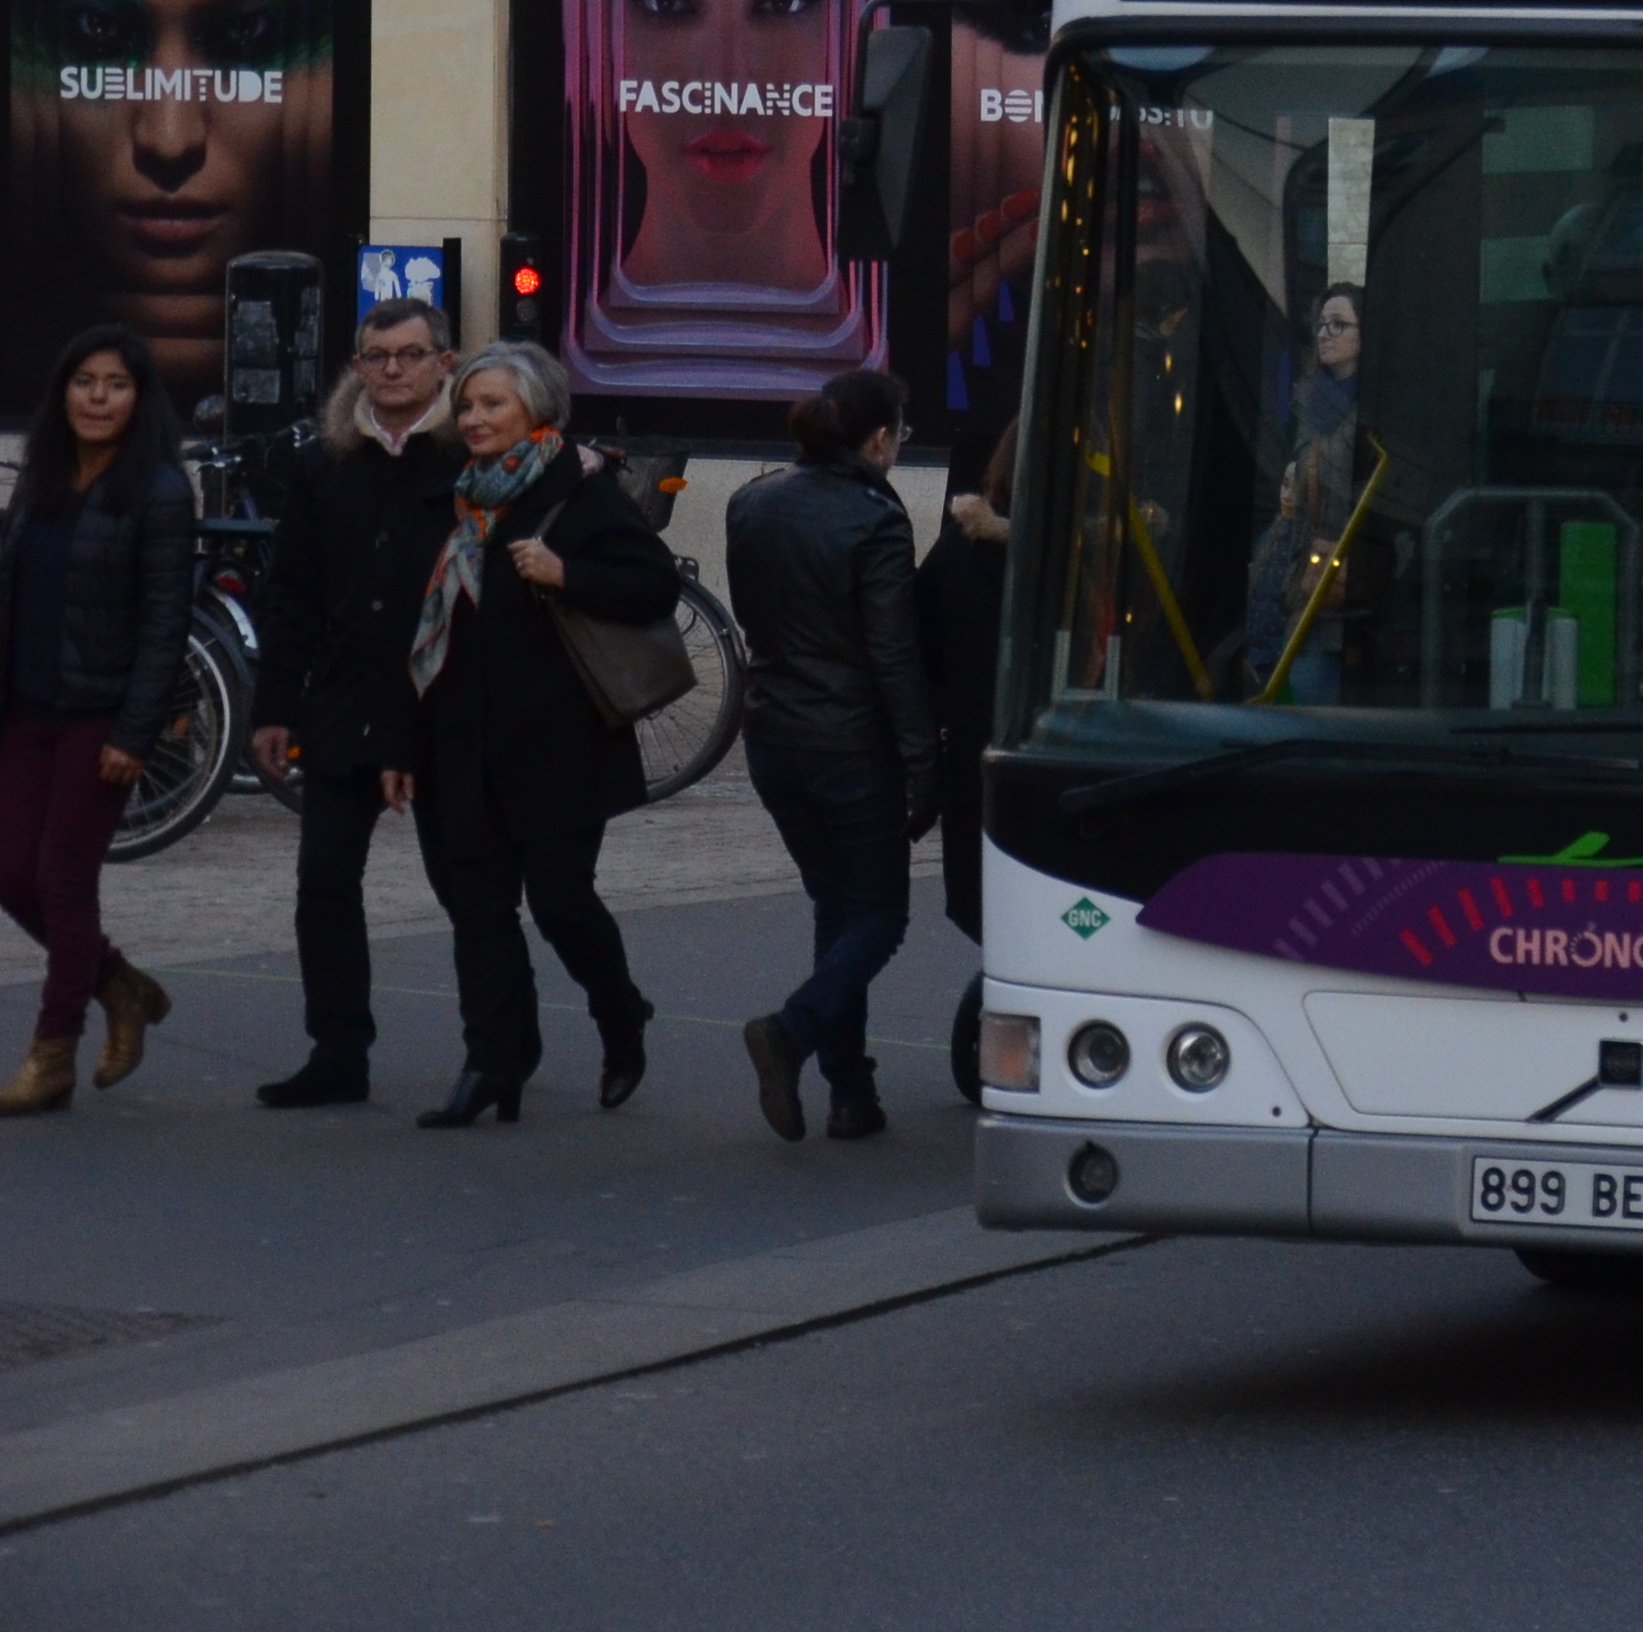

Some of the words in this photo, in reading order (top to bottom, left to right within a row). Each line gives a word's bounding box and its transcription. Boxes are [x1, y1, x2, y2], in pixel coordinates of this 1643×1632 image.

[60, 66, 283, 105] SUBLIMITUDE
[619, 79, 834, 118] FASCINANCE
[1067, 908, 1102, 928] GNC
[1480, 1167, 1566, 1215] 899
